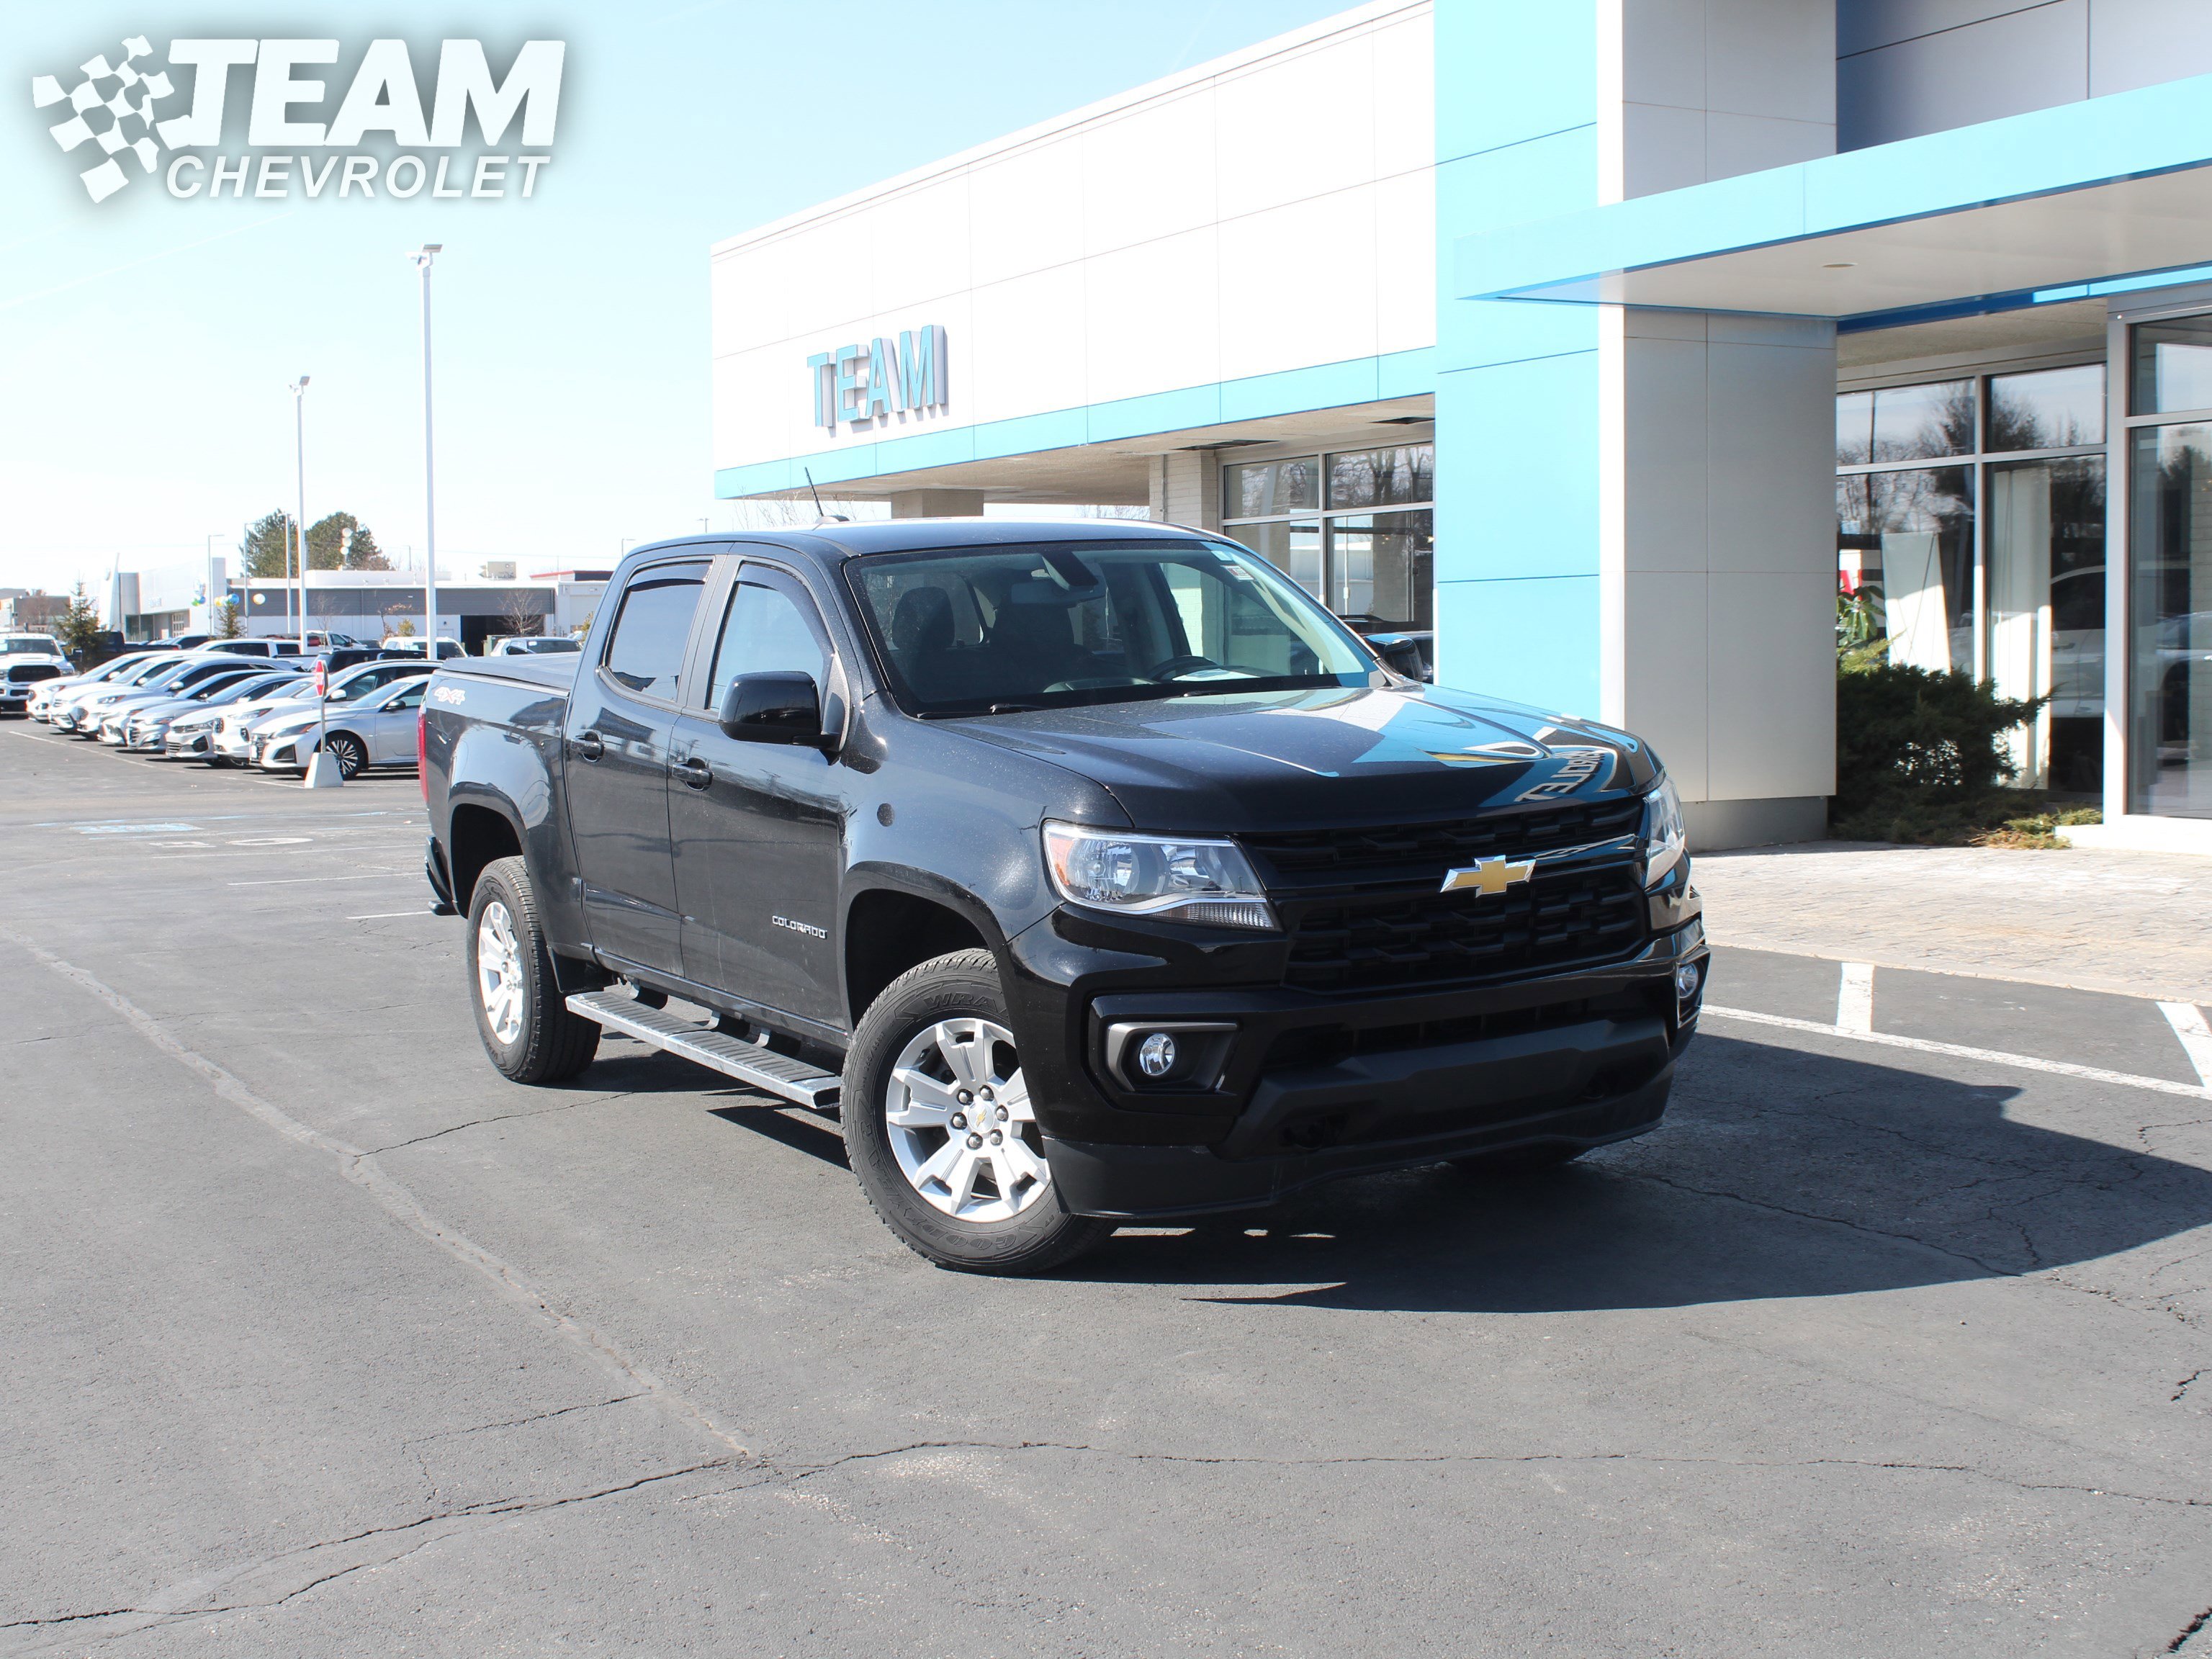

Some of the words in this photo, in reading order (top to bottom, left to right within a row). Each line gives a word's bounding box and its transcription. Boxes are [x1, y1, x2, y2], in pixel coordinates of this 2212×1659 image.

[806, 324, 947, 428] TEAM
[772, 915, 827, 939] COLORADO
[923, 991, 1008, 1017] WRA
[860, 1120, 1017, 1251] GOODYEAR
